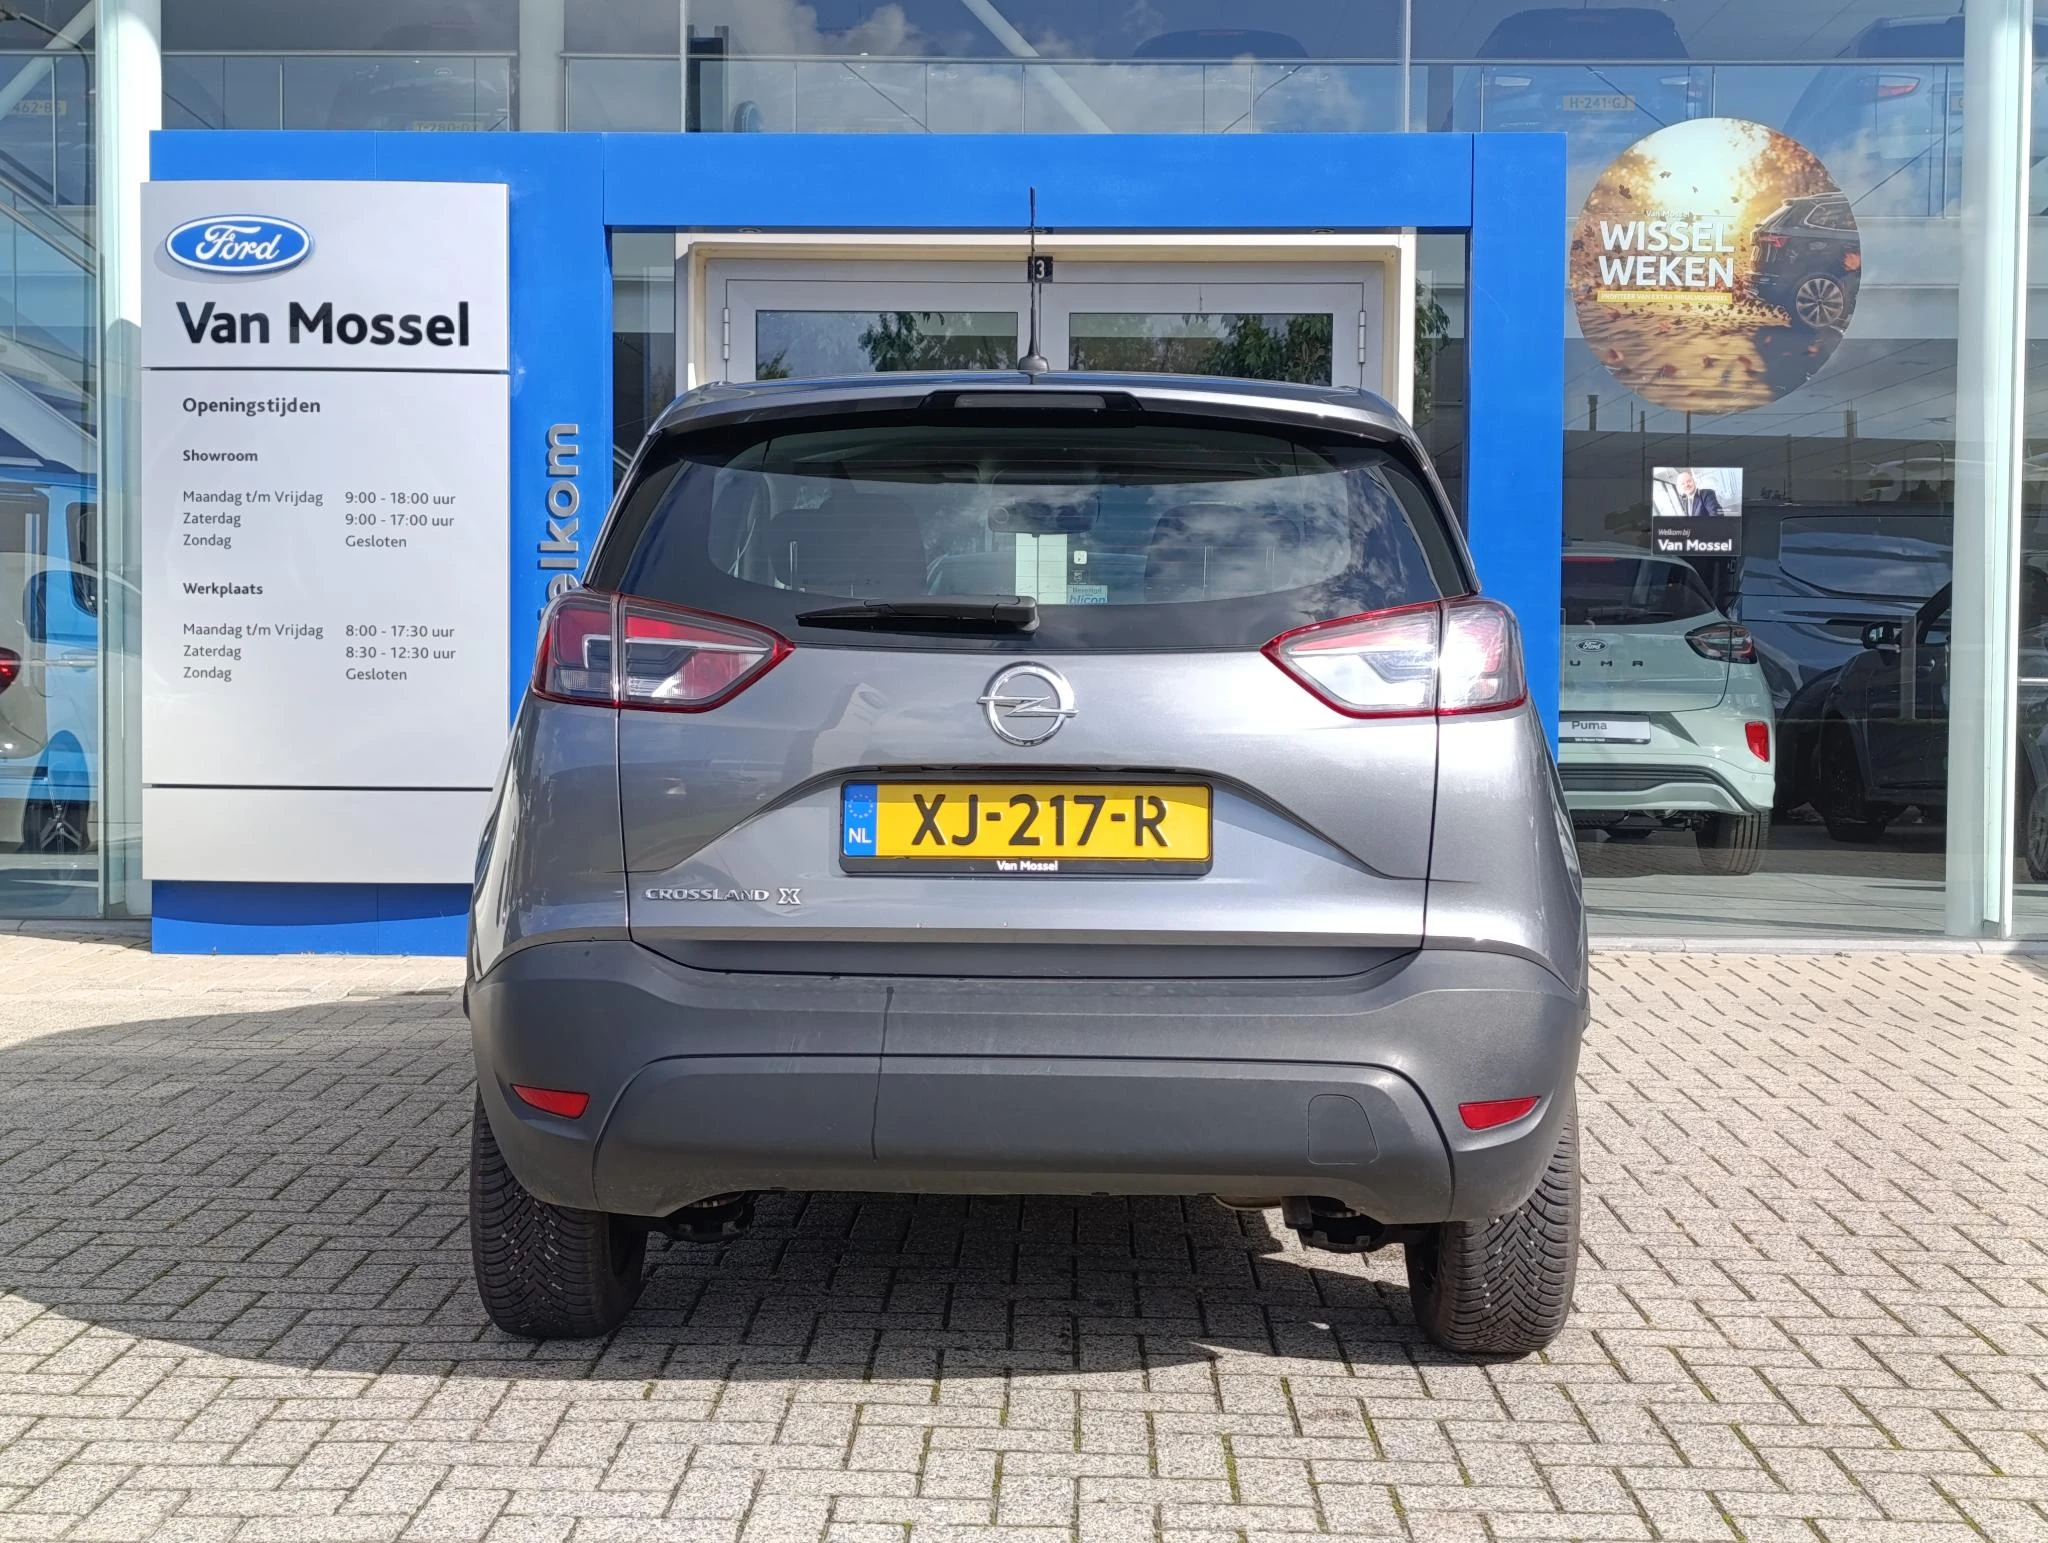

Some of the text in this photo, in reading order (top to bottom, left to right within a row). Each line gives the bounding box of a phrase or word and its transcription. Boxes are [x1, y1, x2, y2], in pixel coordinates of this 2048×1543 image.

[1569, 96, 1628, 109] H-241-GJ
[196, 224, 281, 261] Ford
[1600, 220, 1735, 252] WISSEL
[1036, 260, 1045, 279] 3
[1598, 255, 1735, 287] WEKEN
[176, 302, 469, 346] Van Mossel
[183, 397, 320, 417] Openingstijden
[183, 449, 257, 461] Showroom
[184, 490, 242, 506] Maandag
[246, 490, 270, 502] t/m
[275, 491, 323, 506] Vrijdag
[345, 492, 376, 503] 9:00
[391, 492, 428, 504] 18:00
[433, 496, 455, 504] uur
[184, 512, 241, 528] Zaterdag
[346, 514, 376, 525] 9:00
[391, 514, 427, 526] 17:00
[432, 518, 454, 526] uur
[538, 424, 580, 608] elkom
[184, 534, 406, 549] Zondag Gesloten
[1658, 539, 1732, 552] Van Mossel
[183, 582, 263, 598] Werkplaats
[184, 623, 242, 639] Maandag
[246, 624, 270, 635] t/m
[275, 624, 323, 639] Vrijdag
[346, 625, 377, 636] 8:00
[391, 625, 427, 637] 17:30
[432, 629, 454, 637] uur
[184, 645, 241, 660] Zaterdag
[346, 647, 376, 658] 8:30
[391, 647, 428, 658] 12:30
[434, 651, 456, 659] uur
[184, 666, 407, 682] Zondag Gesloten
[1571, 721, 1608, 730] Puma
[912, 794, 1168, 847] XJ-217-R
[849, 828, 872, 844] NL
[997, 860, 1058, 871] Van Mossel
[645, 887, 802, 905] CROSSLAND X
